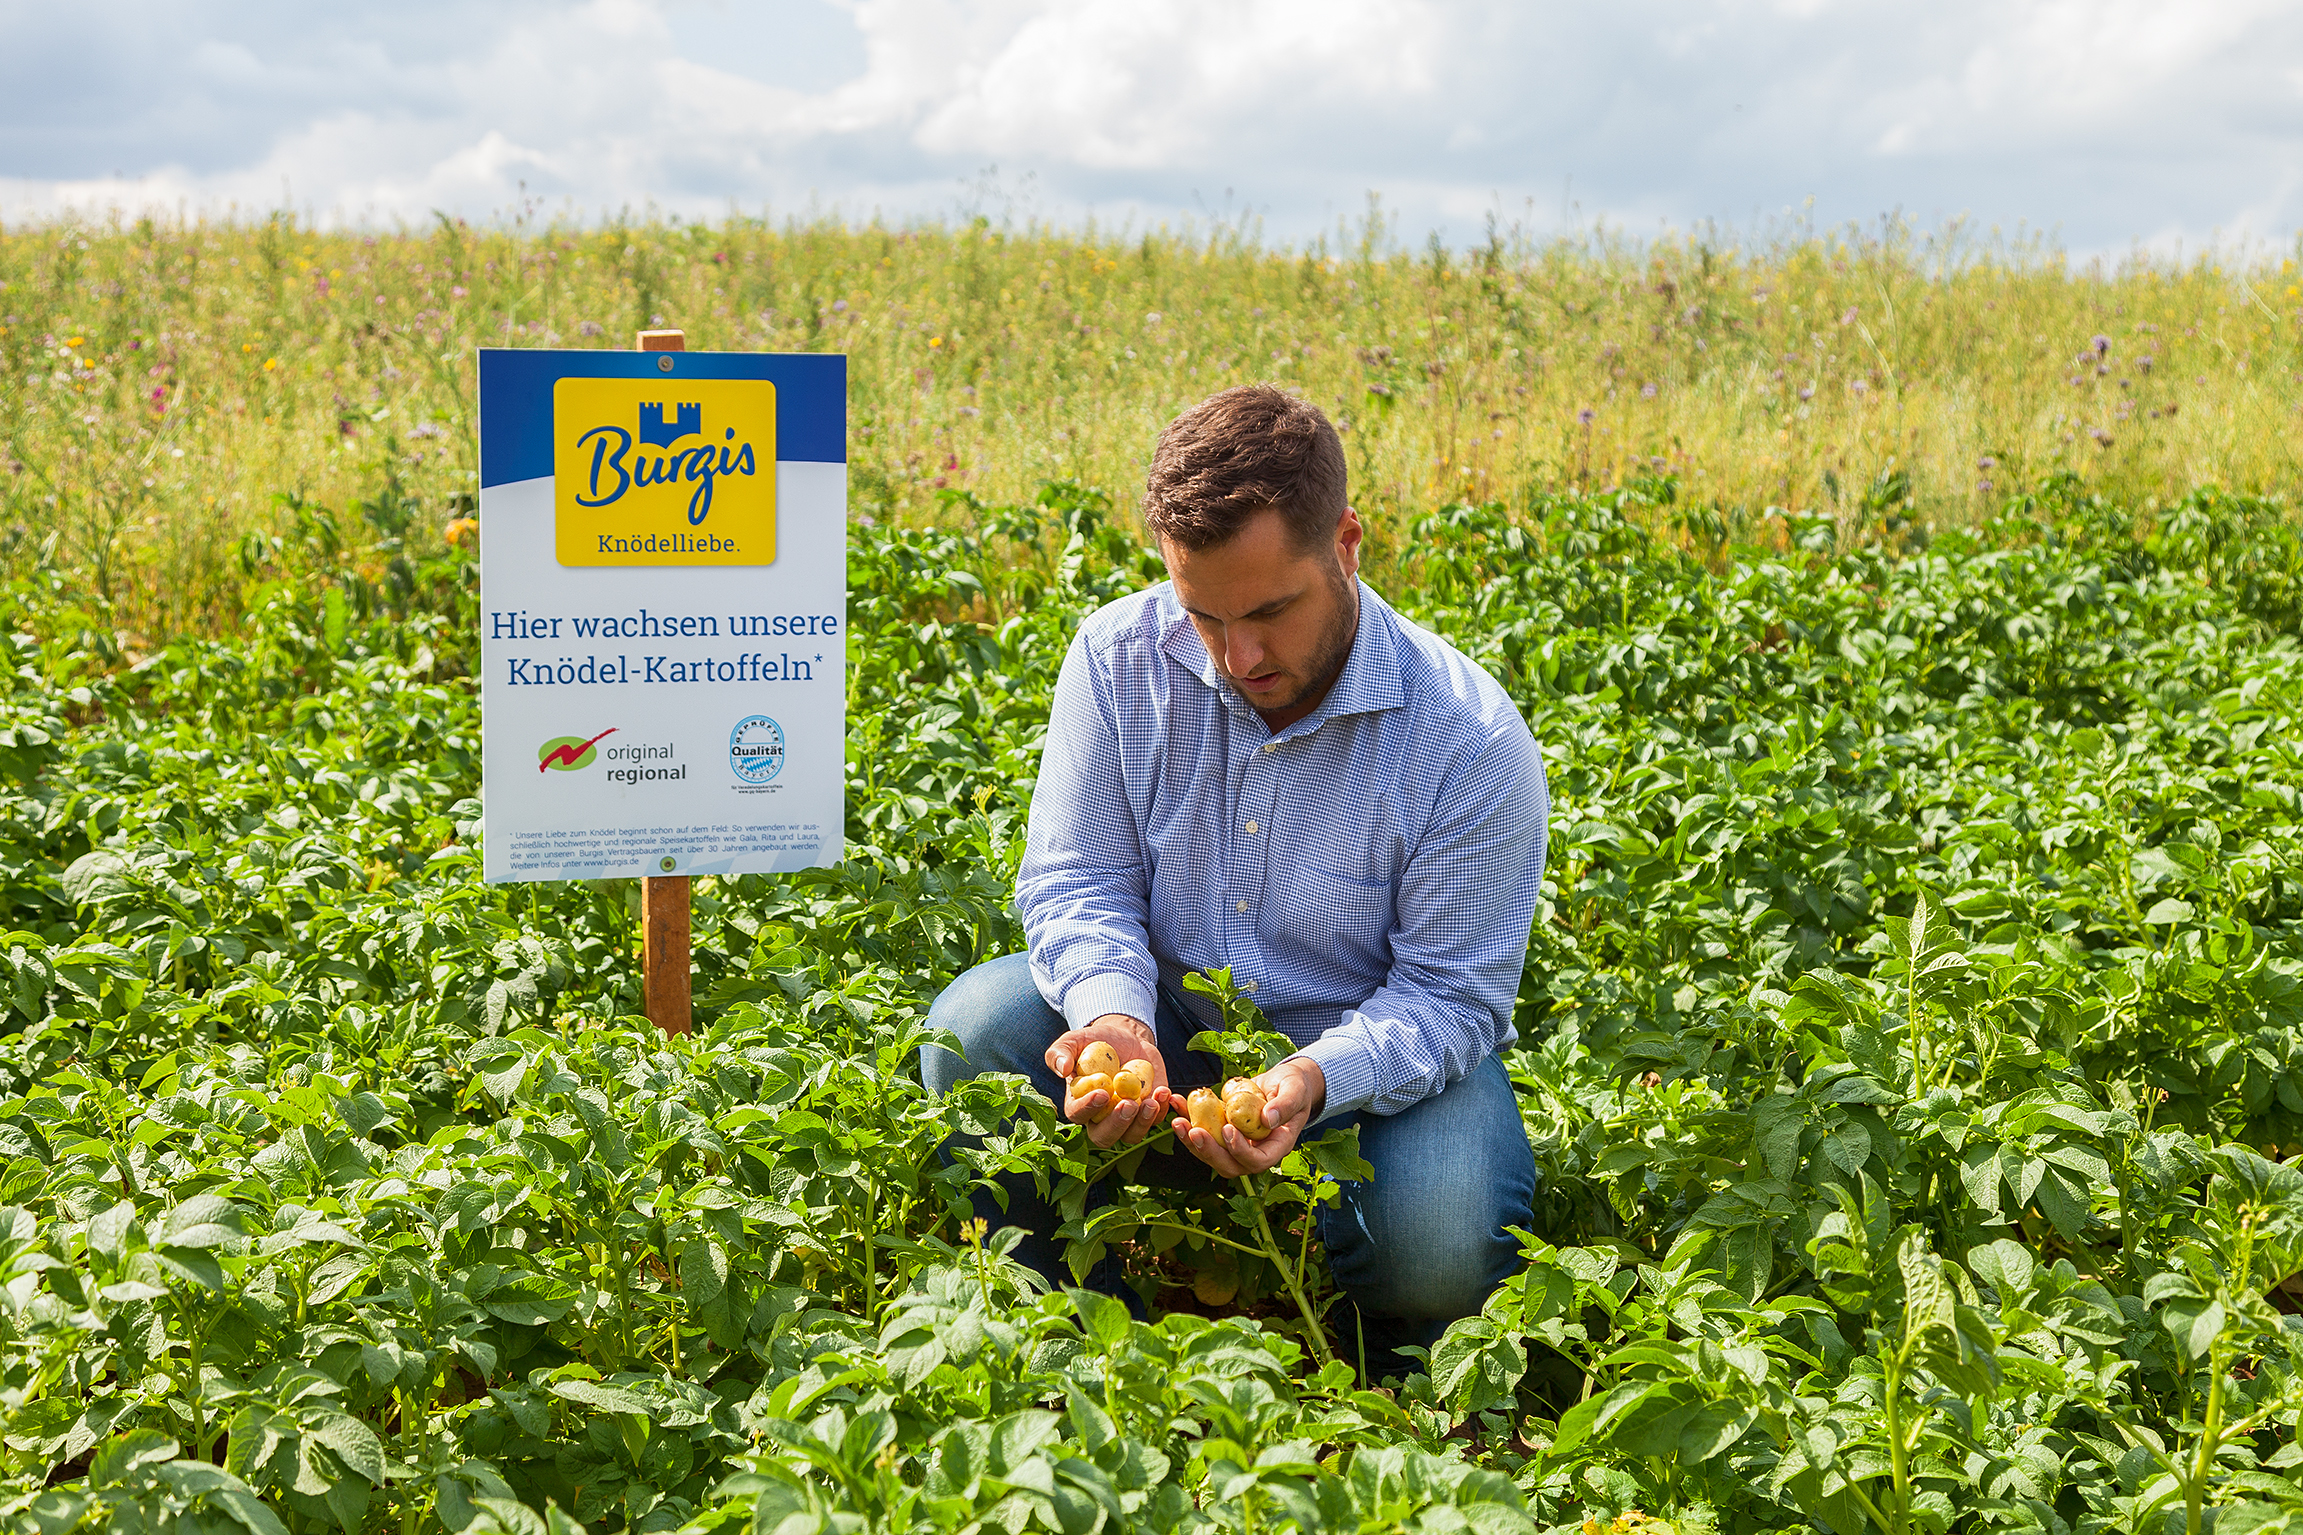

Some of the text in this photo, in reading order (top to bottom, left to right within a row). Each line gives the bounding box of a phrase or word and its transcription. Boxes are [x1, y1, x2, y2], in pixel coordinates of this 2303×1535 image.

[575, 425, 755, 525] Burgis
[598, 533, 740, 552] Knödelliebe.
[490, 609, 838, 639] Hier wachsen unsere
[607, 742, 673, 763] original
[732, 746, 782, 756] Qualität
[607, 764, 686, 785] regional
[546, 830, 566, 838] Liebe
[589, 828, 616, 836] Knödel
[618, 828, 647, 837] beginnt
[650, 827, 673, 835] schon
[676, 826, 688, 834] auf
[745, 824, 786, 832] verwenden
[510, 840, 550, 849] schließlich
[553, 839, 601, 848] hochwertige
[604, 838, 619, 846] und
[621, 836, 656, 846] regionale
[659, 834, 720, 844] Speisekartoffeln
[723, 834, 736, 842] wie
[761, 833, 776, 841] Rita
[779, 833, 794, 841] und
[510, 852, 521, 860] die
[544, 851, 575, 859] unseren
[579, 850, 604, 858] Burgis
[607, 847, 665, 856] Vertragsbauern
[669, 846, 683, 854] seit
[687, 845, 704, 853] über
[722, 844, 748, 852] Jahren
[751, 843, 787, 853] angebaut
[510, 858, 639, 870] Weitere Infos unter www.burgis.de
